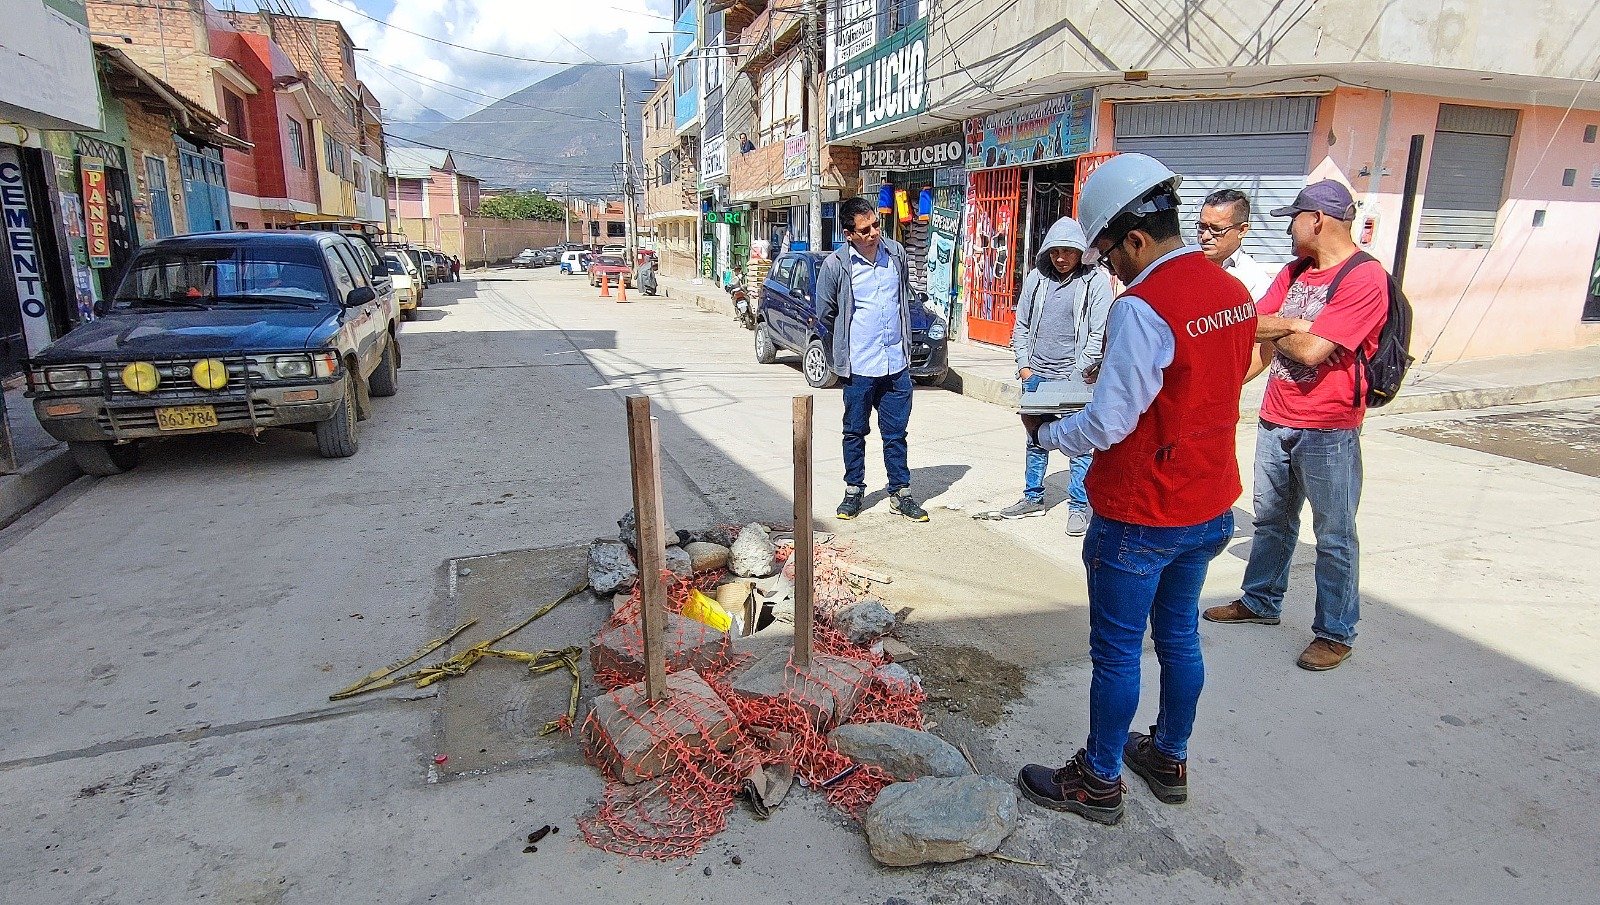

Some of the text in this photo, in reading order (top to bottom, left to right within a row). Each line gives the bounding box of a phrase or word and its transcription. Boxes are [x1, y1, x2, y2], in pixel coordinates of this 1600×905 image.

[827, 39, 925, 140] PEPE LUCHO
[860, 149, 896, 166] PEPE
[899, 141, 962, 166] LUCHO
[0, 162, 46, 318] CEMENTO
[88, 171, 106, 254] PANES
